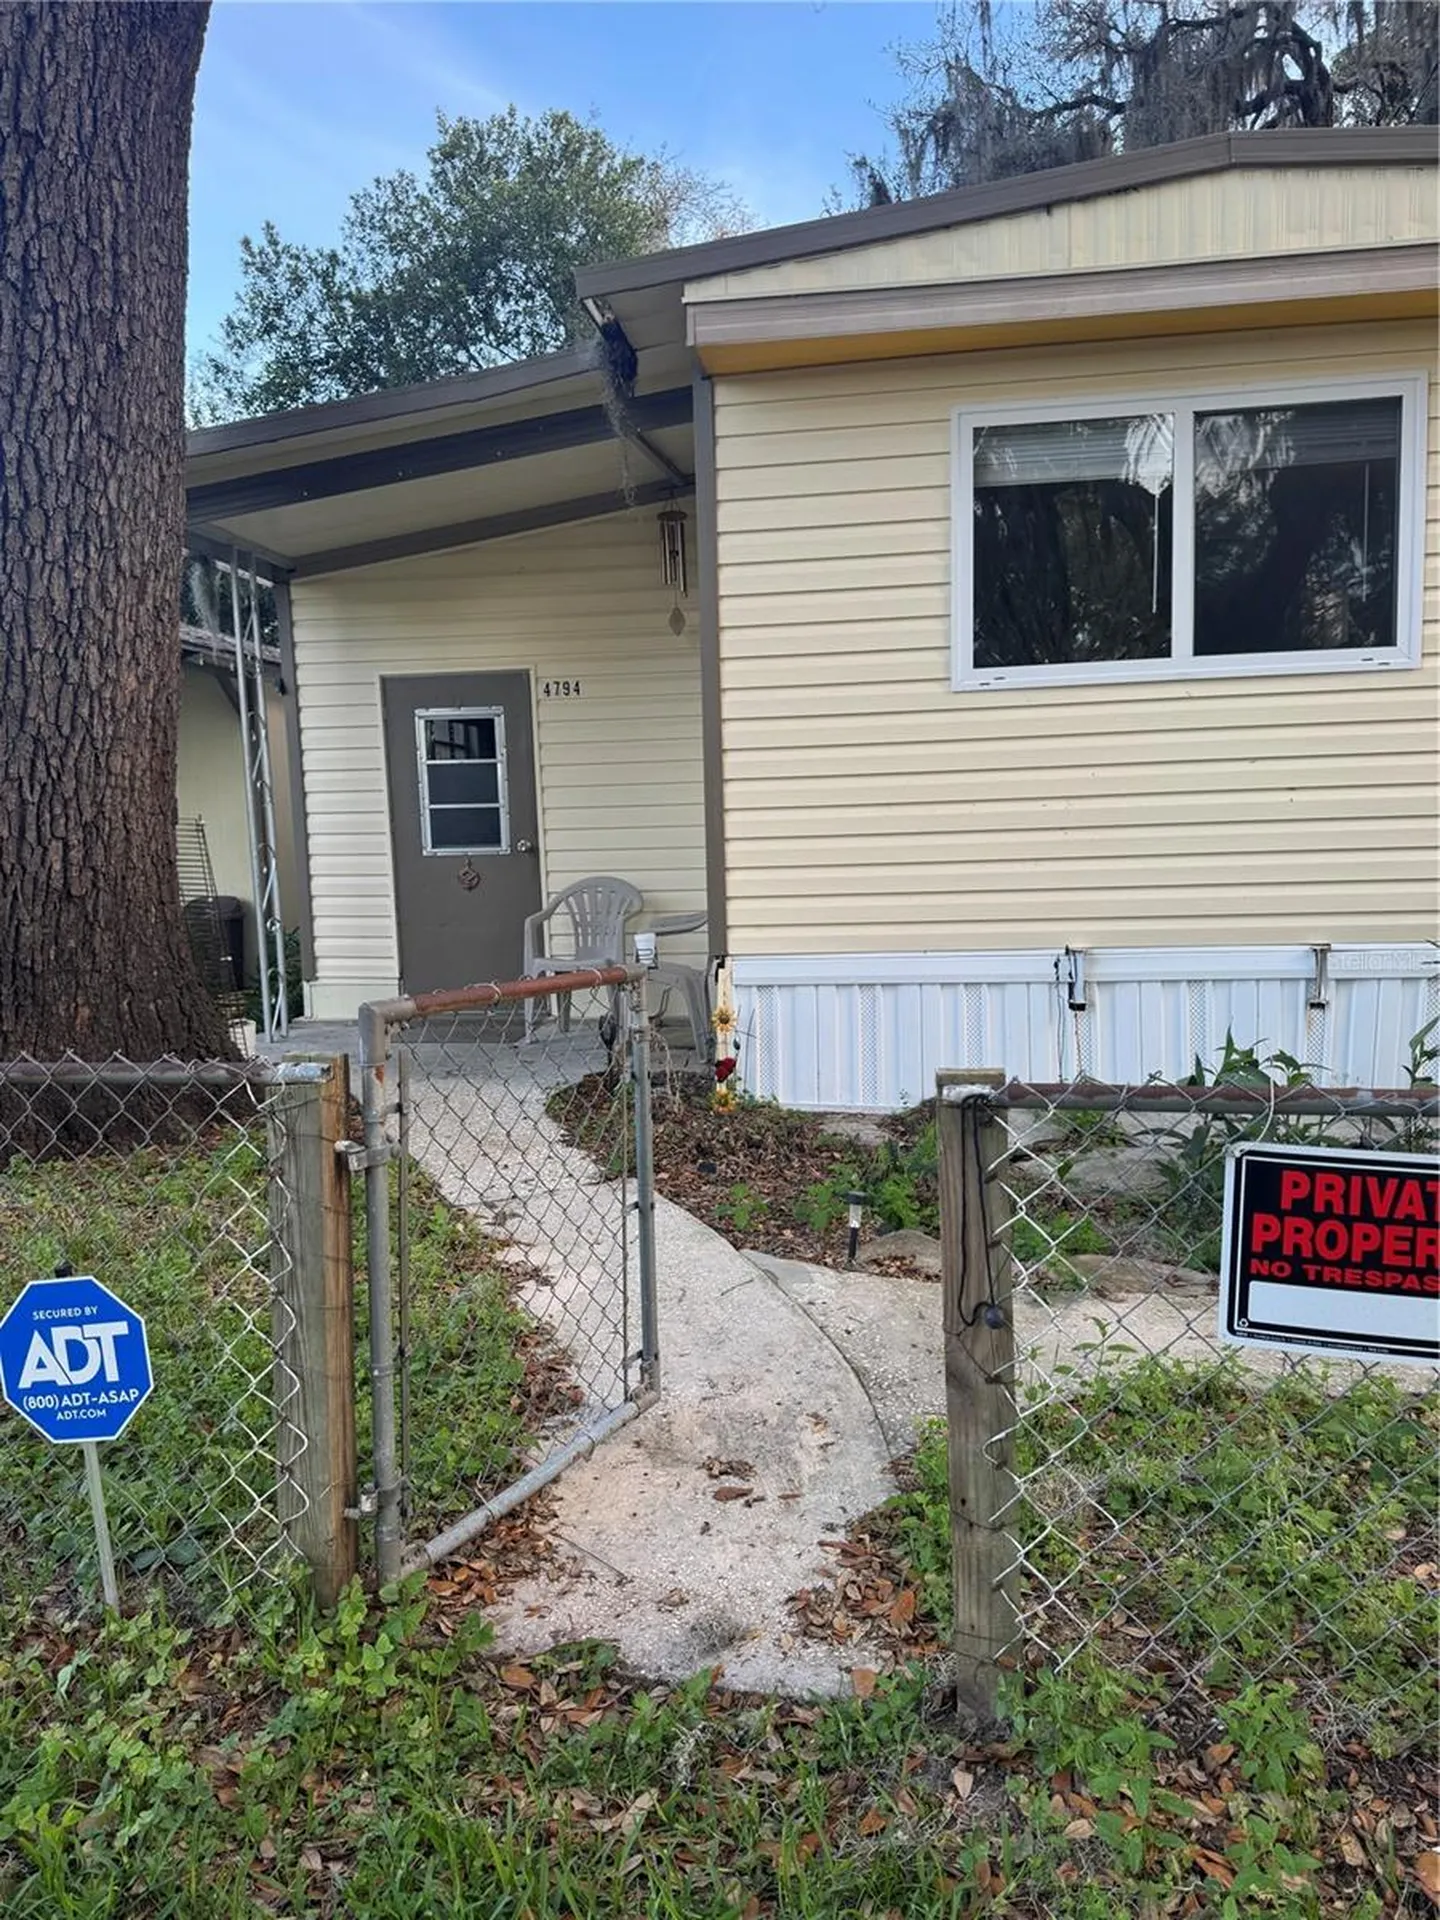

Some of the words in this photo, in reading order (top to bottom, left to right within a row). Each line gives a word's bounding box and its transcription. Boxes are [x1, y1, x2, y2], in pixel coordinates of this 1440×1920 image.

[543, 680, 580, 697] 4794
[1252, 1212, 1440, 1269] PROPER
[1250, 1258, 1292, 1278] NO
[1302, 1264, 1440, 1293] TRESPAS
[32, 1308, 81, 1320] SECURED
[84, 1306, 98, 1316] BY
[18, 1322, 129, 1389] ADT
[23, 1394, 60, 1412] (800)
[61, 1389, 139, 1408] ADT-ASAP
[56, 1408, 107, 1421] ADT.COM
